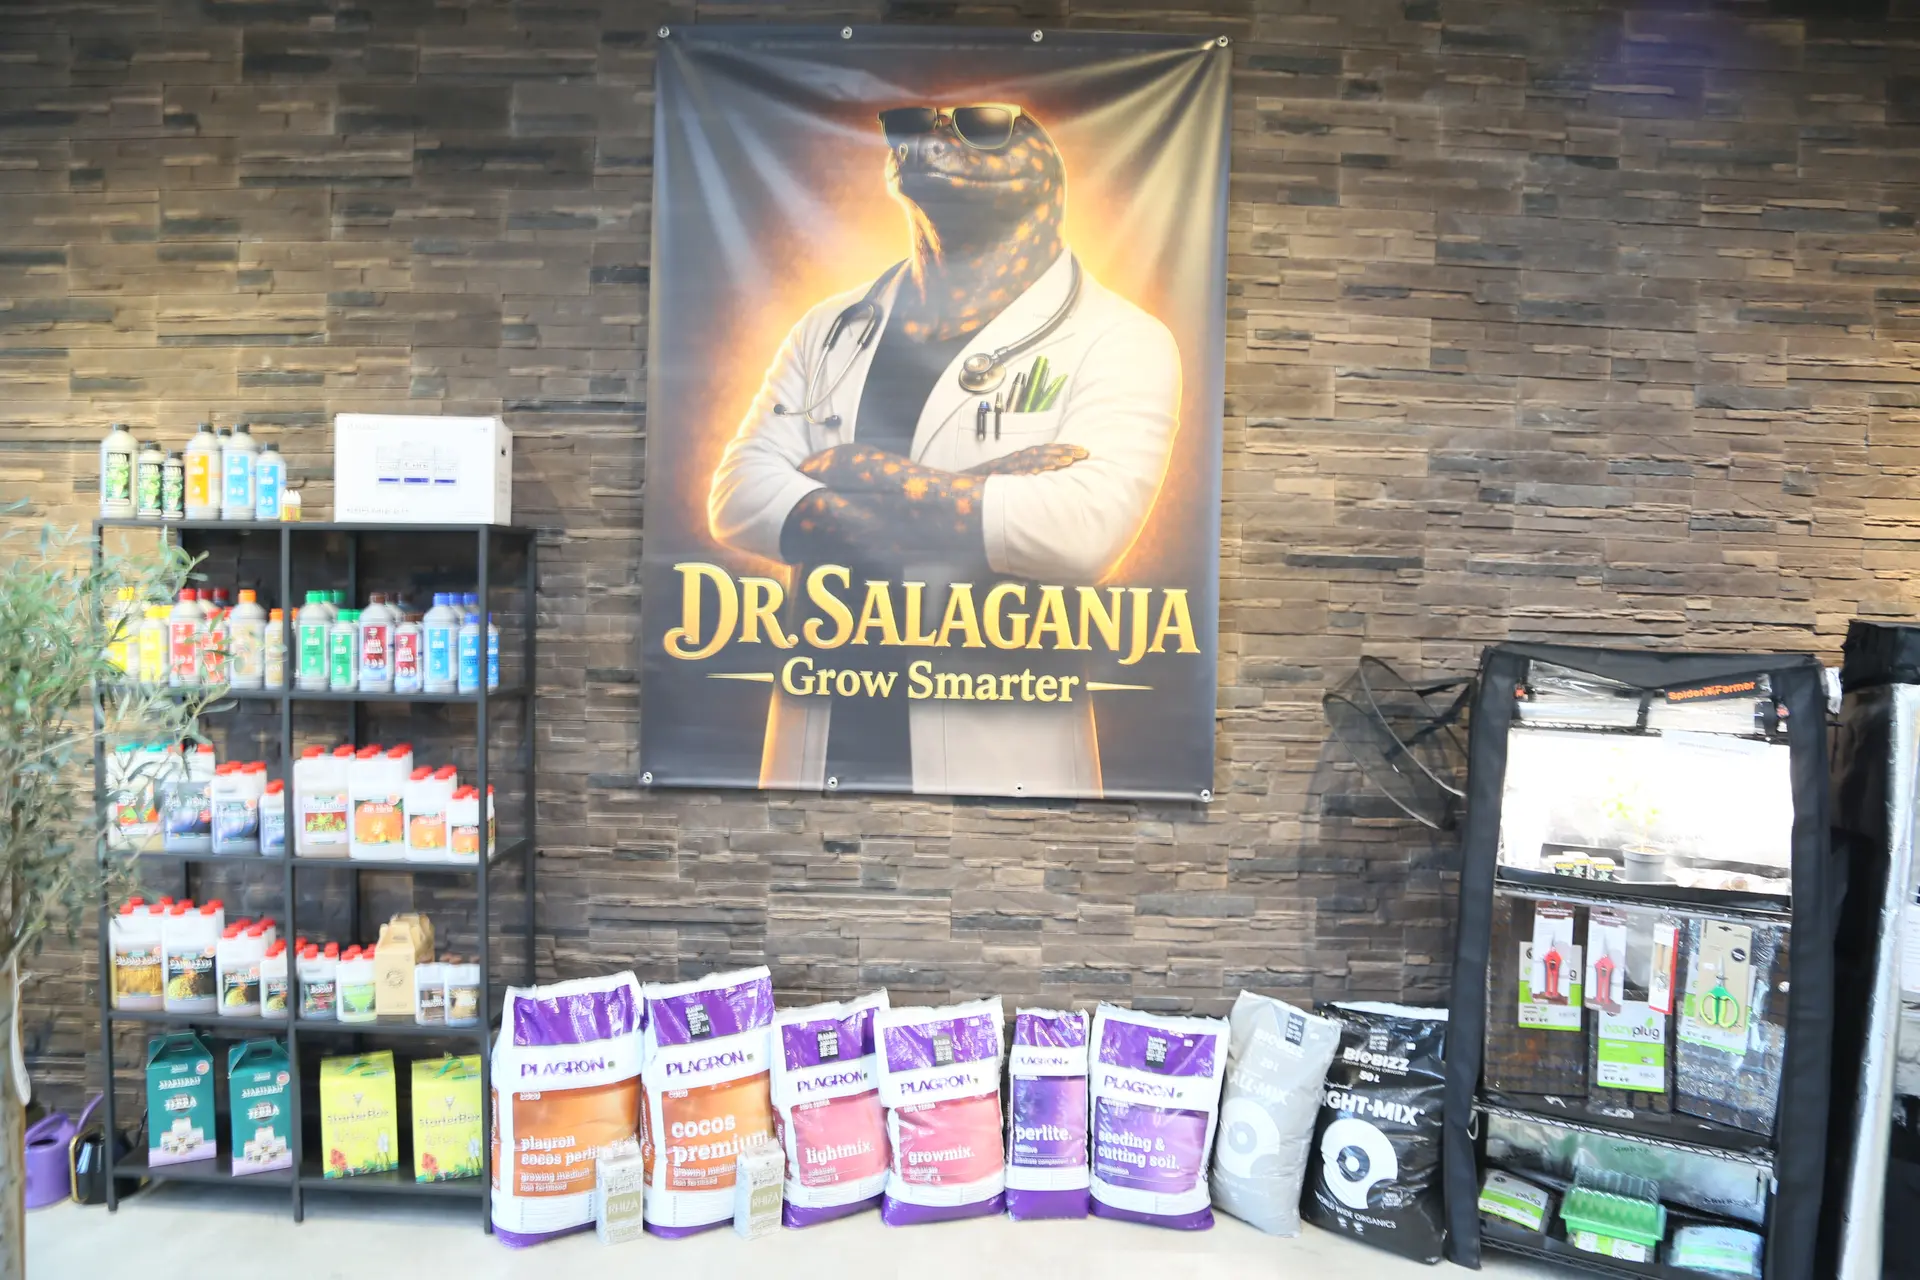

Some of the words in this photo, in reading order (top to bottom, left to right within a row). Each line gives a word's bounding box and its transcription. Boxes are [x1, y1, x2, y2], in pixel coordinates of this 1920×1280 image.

[663, 562, 799, 660] DR
[803, 564, 1201, 666] SALAGANJA
[781, 656, 899, 698] Grow
[907, 660, 1080, 702] Smarter
[665, 1049, 745, 1077] PLAGRON
[797, 1070, 864, 1093] PLAGRON
[671, 1114, 736, 1138] cocos
[1014, 1123, 1073, 1143] perlite.
[1097, 1128, 1152, 1153] seeding
[1154, 1135, 1166, 1153] &
[1097, 1144, 1147, 1169] cutting
